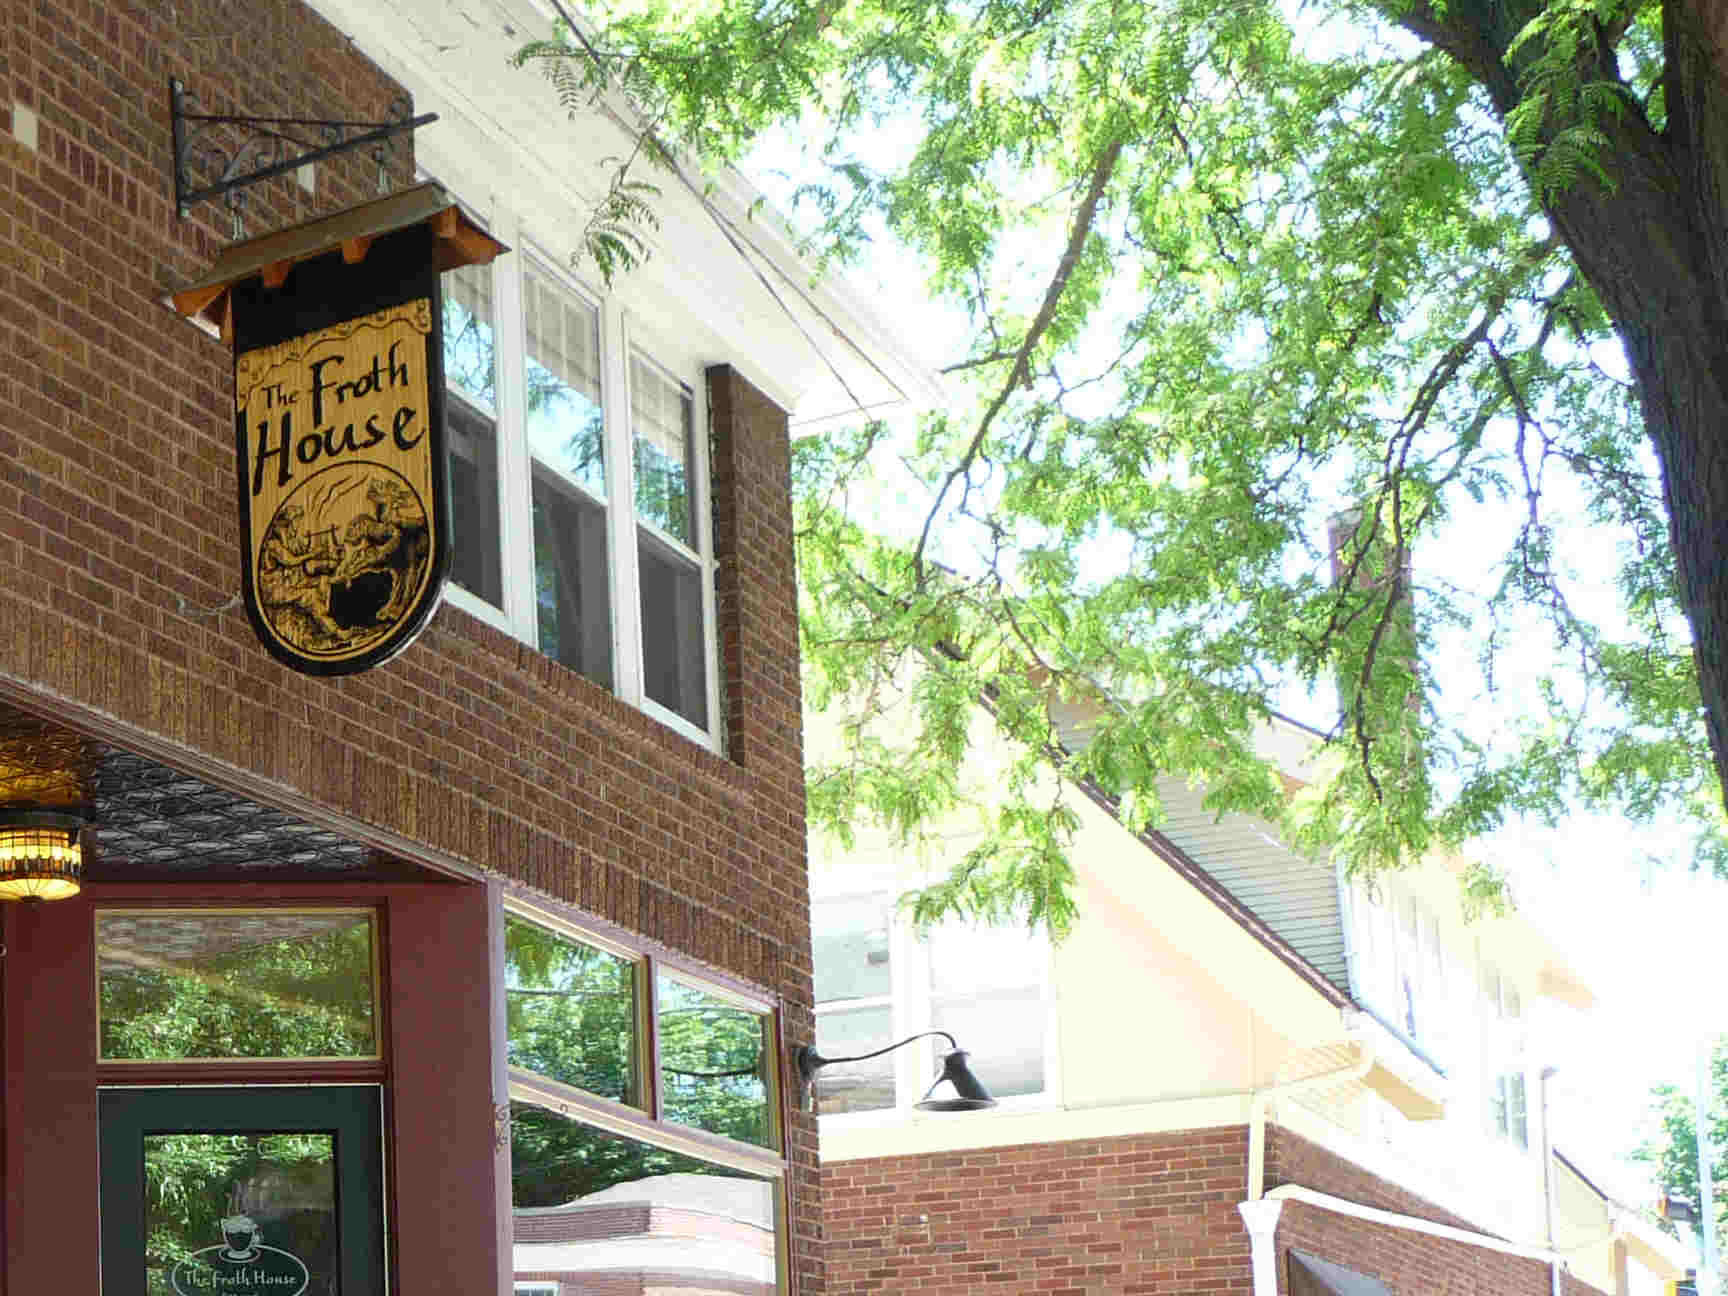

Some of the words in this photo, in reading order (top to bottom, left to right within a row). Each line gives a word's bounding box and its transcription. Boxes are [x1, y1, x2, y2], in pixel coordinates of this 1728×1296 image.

[261, 382, 299, 409] The
[309, 339, 409, 430] Froth
[252, 406, 427, 497] House
[183, 1268, 211, 1288] The
[211, 1266, 250, 1288] Froth
[253, 1268, 296, 1285] House
